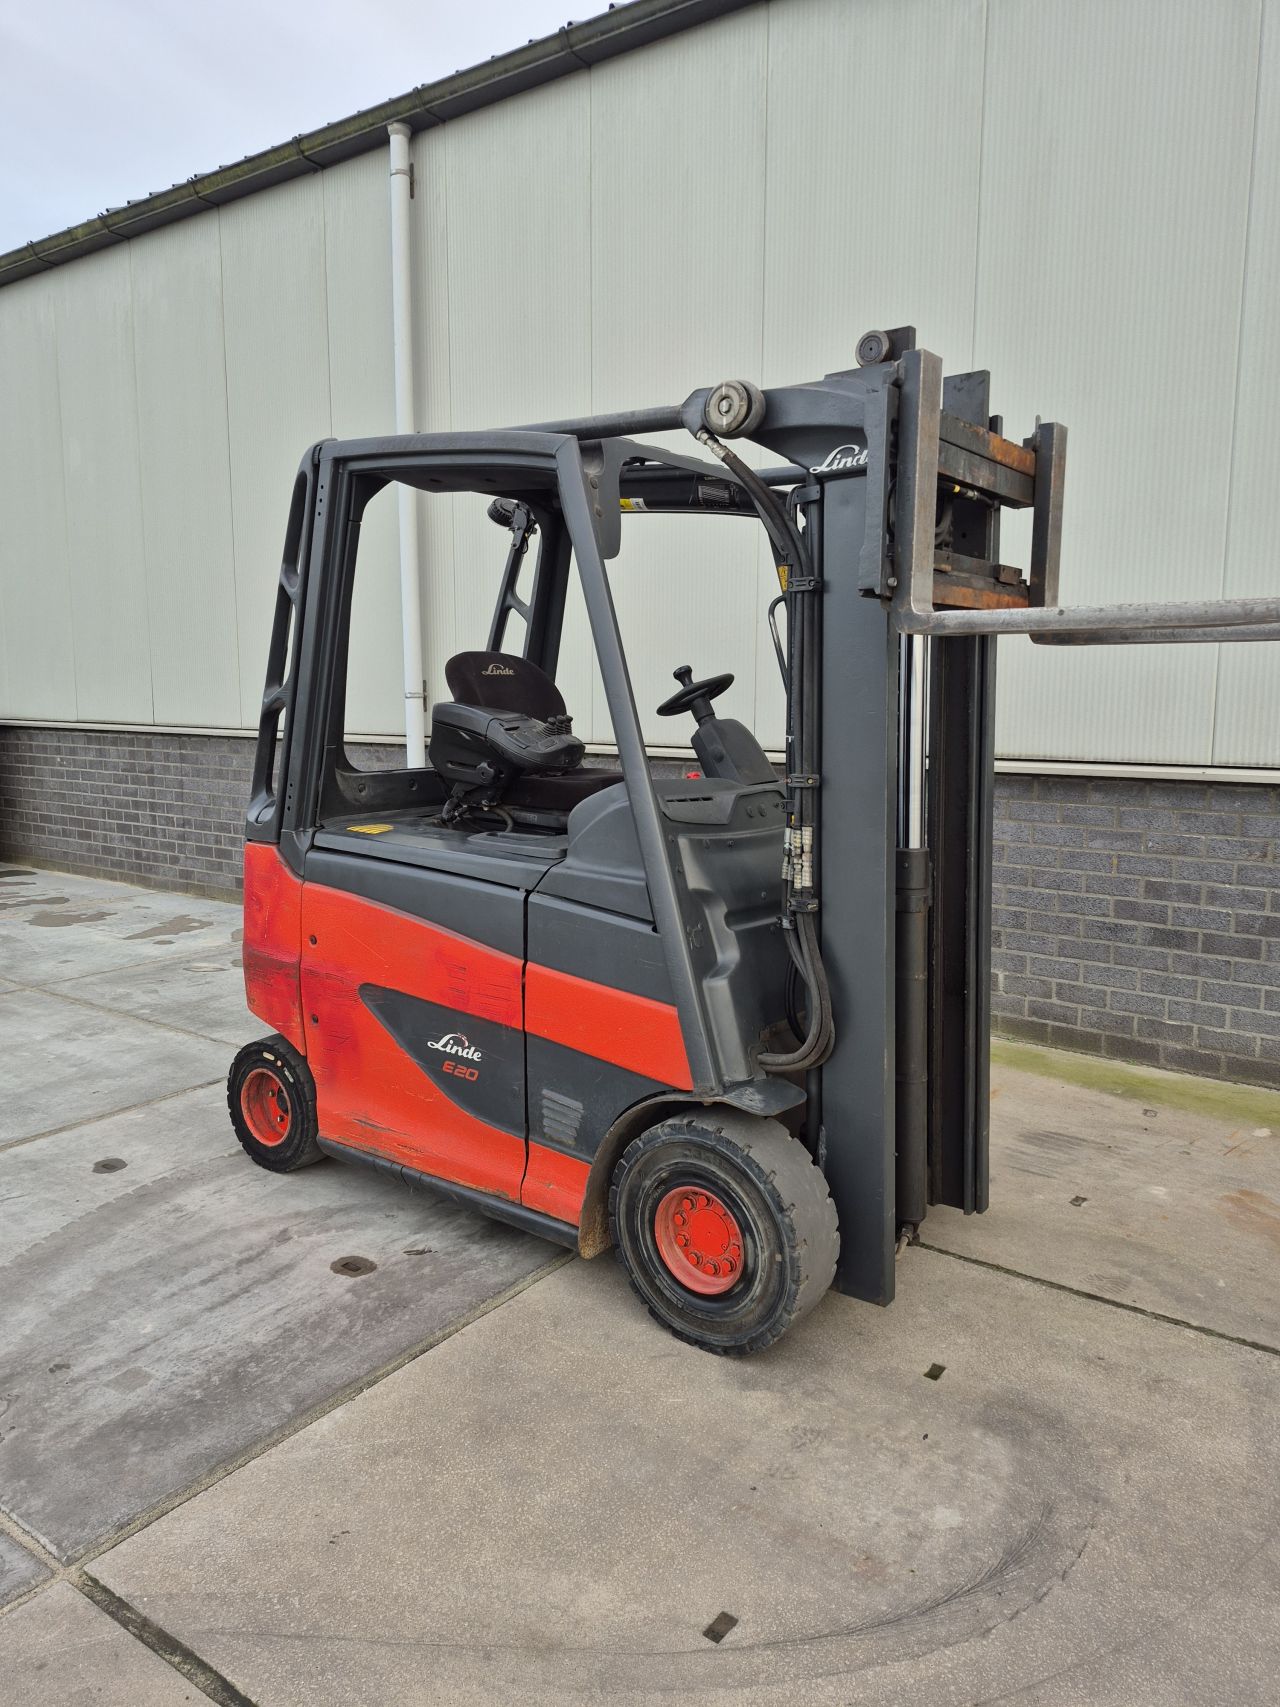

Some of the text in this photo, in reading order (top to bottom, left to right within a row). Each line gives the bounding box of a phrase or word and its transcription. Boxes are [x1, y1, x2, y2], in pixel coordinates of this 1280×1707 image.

[809, 444, 868, 473] Lind
[481, 663, 514, 675] Linde
[427, 1033, 482, 1061] Linde
[442, 1060, 479, 1080] E20
